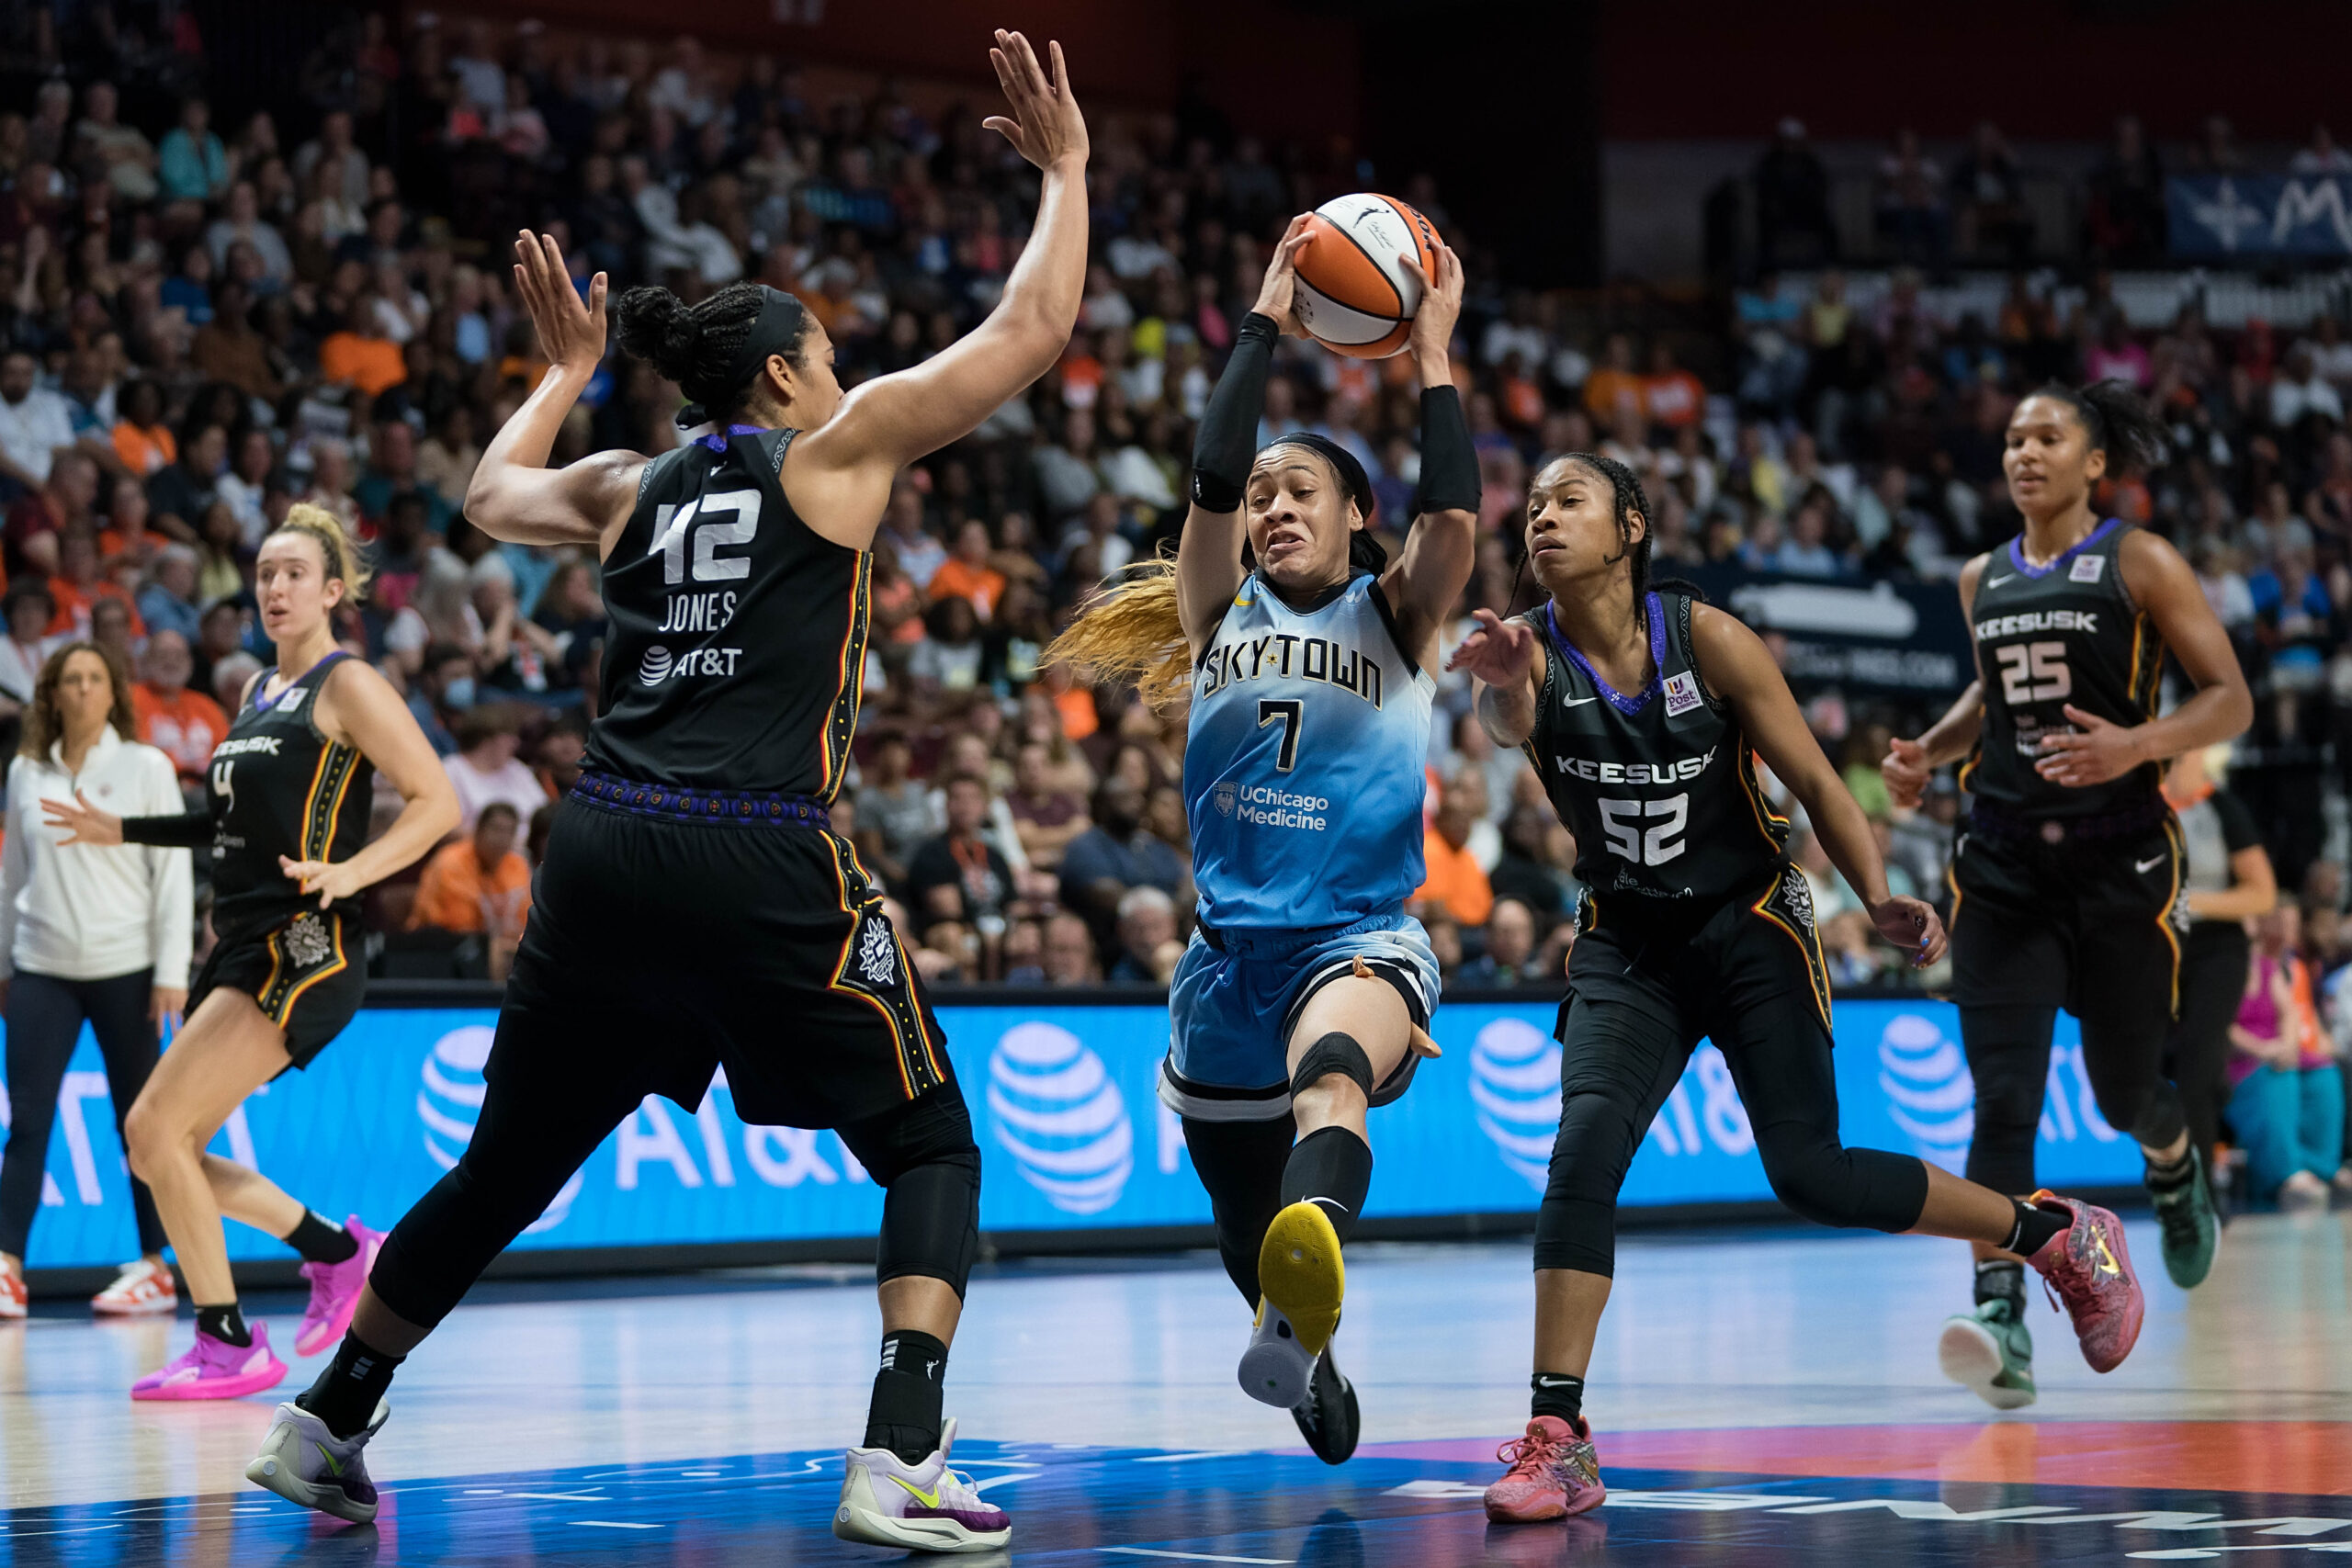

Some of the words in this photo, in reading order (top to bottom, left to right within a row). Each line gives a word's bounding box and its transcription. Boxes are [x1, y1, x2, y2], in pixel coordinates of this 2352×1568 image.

[648, 489, 762, 585] 42
[658, 591, 737, 632] JONES
[1975, 611, 2098, 640] KEESUSK
[671, 648, 742, 678] AT&T
[1996, 641, 2072, 705] 25
[1668, 690, 1696, 708] Post
[1258, 699, 1304, 773] 7
[1555, 745, 1717, 784] KEESUSK
[213, 760, 235, 814] 4
[1239, 784, 1329, 812] UChicago
[1237, 804, 1327, 831] Medicine
[1598, 792, 1689, 867] 52
